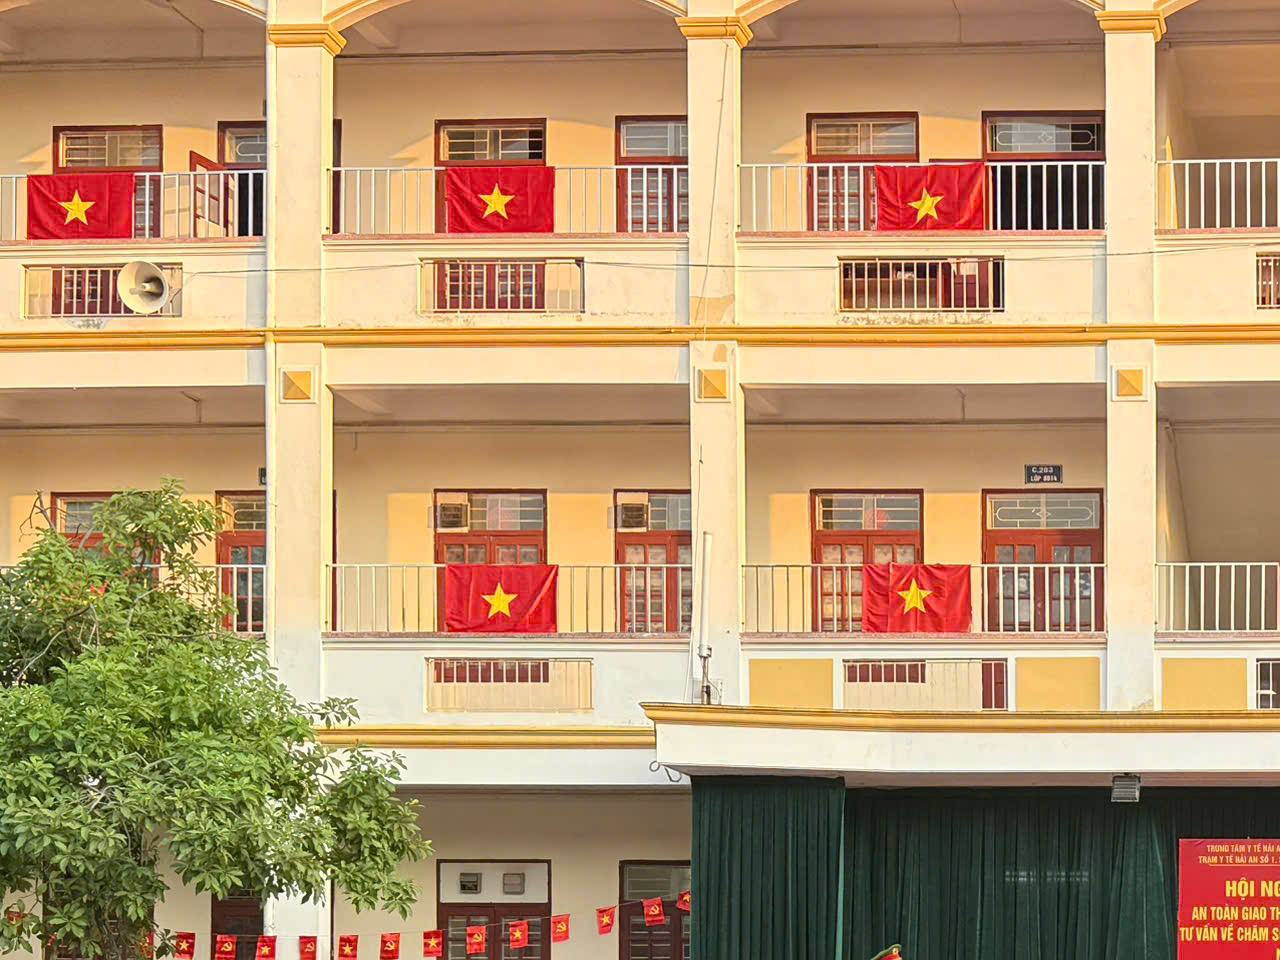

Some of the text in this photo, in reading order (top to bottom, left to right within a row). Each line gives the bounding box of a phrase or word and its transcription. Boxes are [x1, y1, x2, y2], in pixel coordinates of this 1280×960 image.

[1253, 843, 1262, 852] TẾ
[1225, 854, 1233, 863] TẾ
[1226, 877, 1254, 900] HỘI
[1192, 906, 1207, 920] AN
[1210, 904, 1238, 920] TOÀN
[1242, 906, 1267, 920] GIAO
[1180, 927, 1194, 941] TƯ
[1196, 923, 1218, 941] VẤN
[1221, 923, 1234, 941] VỀ
[1237, 924, 1268, 941] CHĂM
